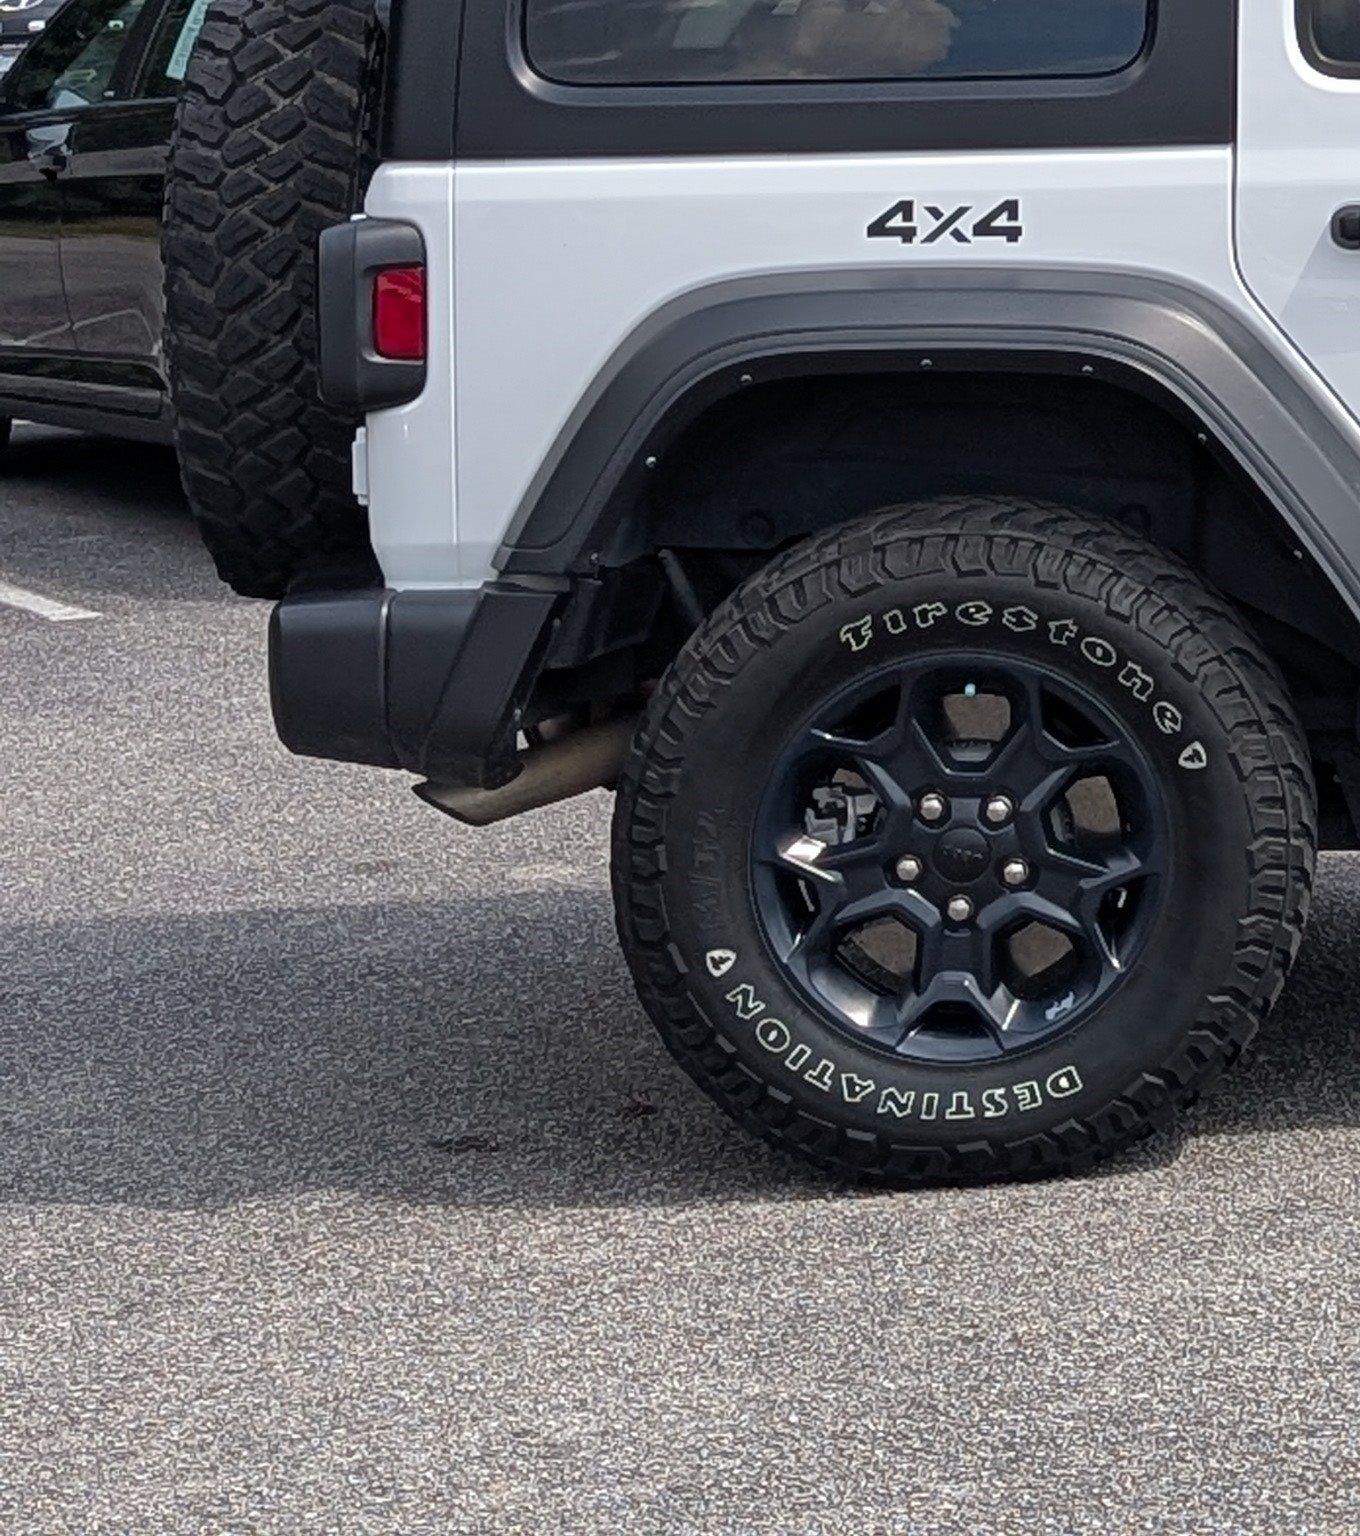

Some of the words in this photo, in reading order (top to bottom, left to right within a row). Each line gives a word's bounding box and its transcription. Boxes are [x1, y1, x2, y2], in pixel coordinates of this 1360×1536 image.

[866, 199, 1023, 244] 4x4
[840, 600, 1183, 735] Firestone
[725, 985, 1084, 1121] DESTINATION
